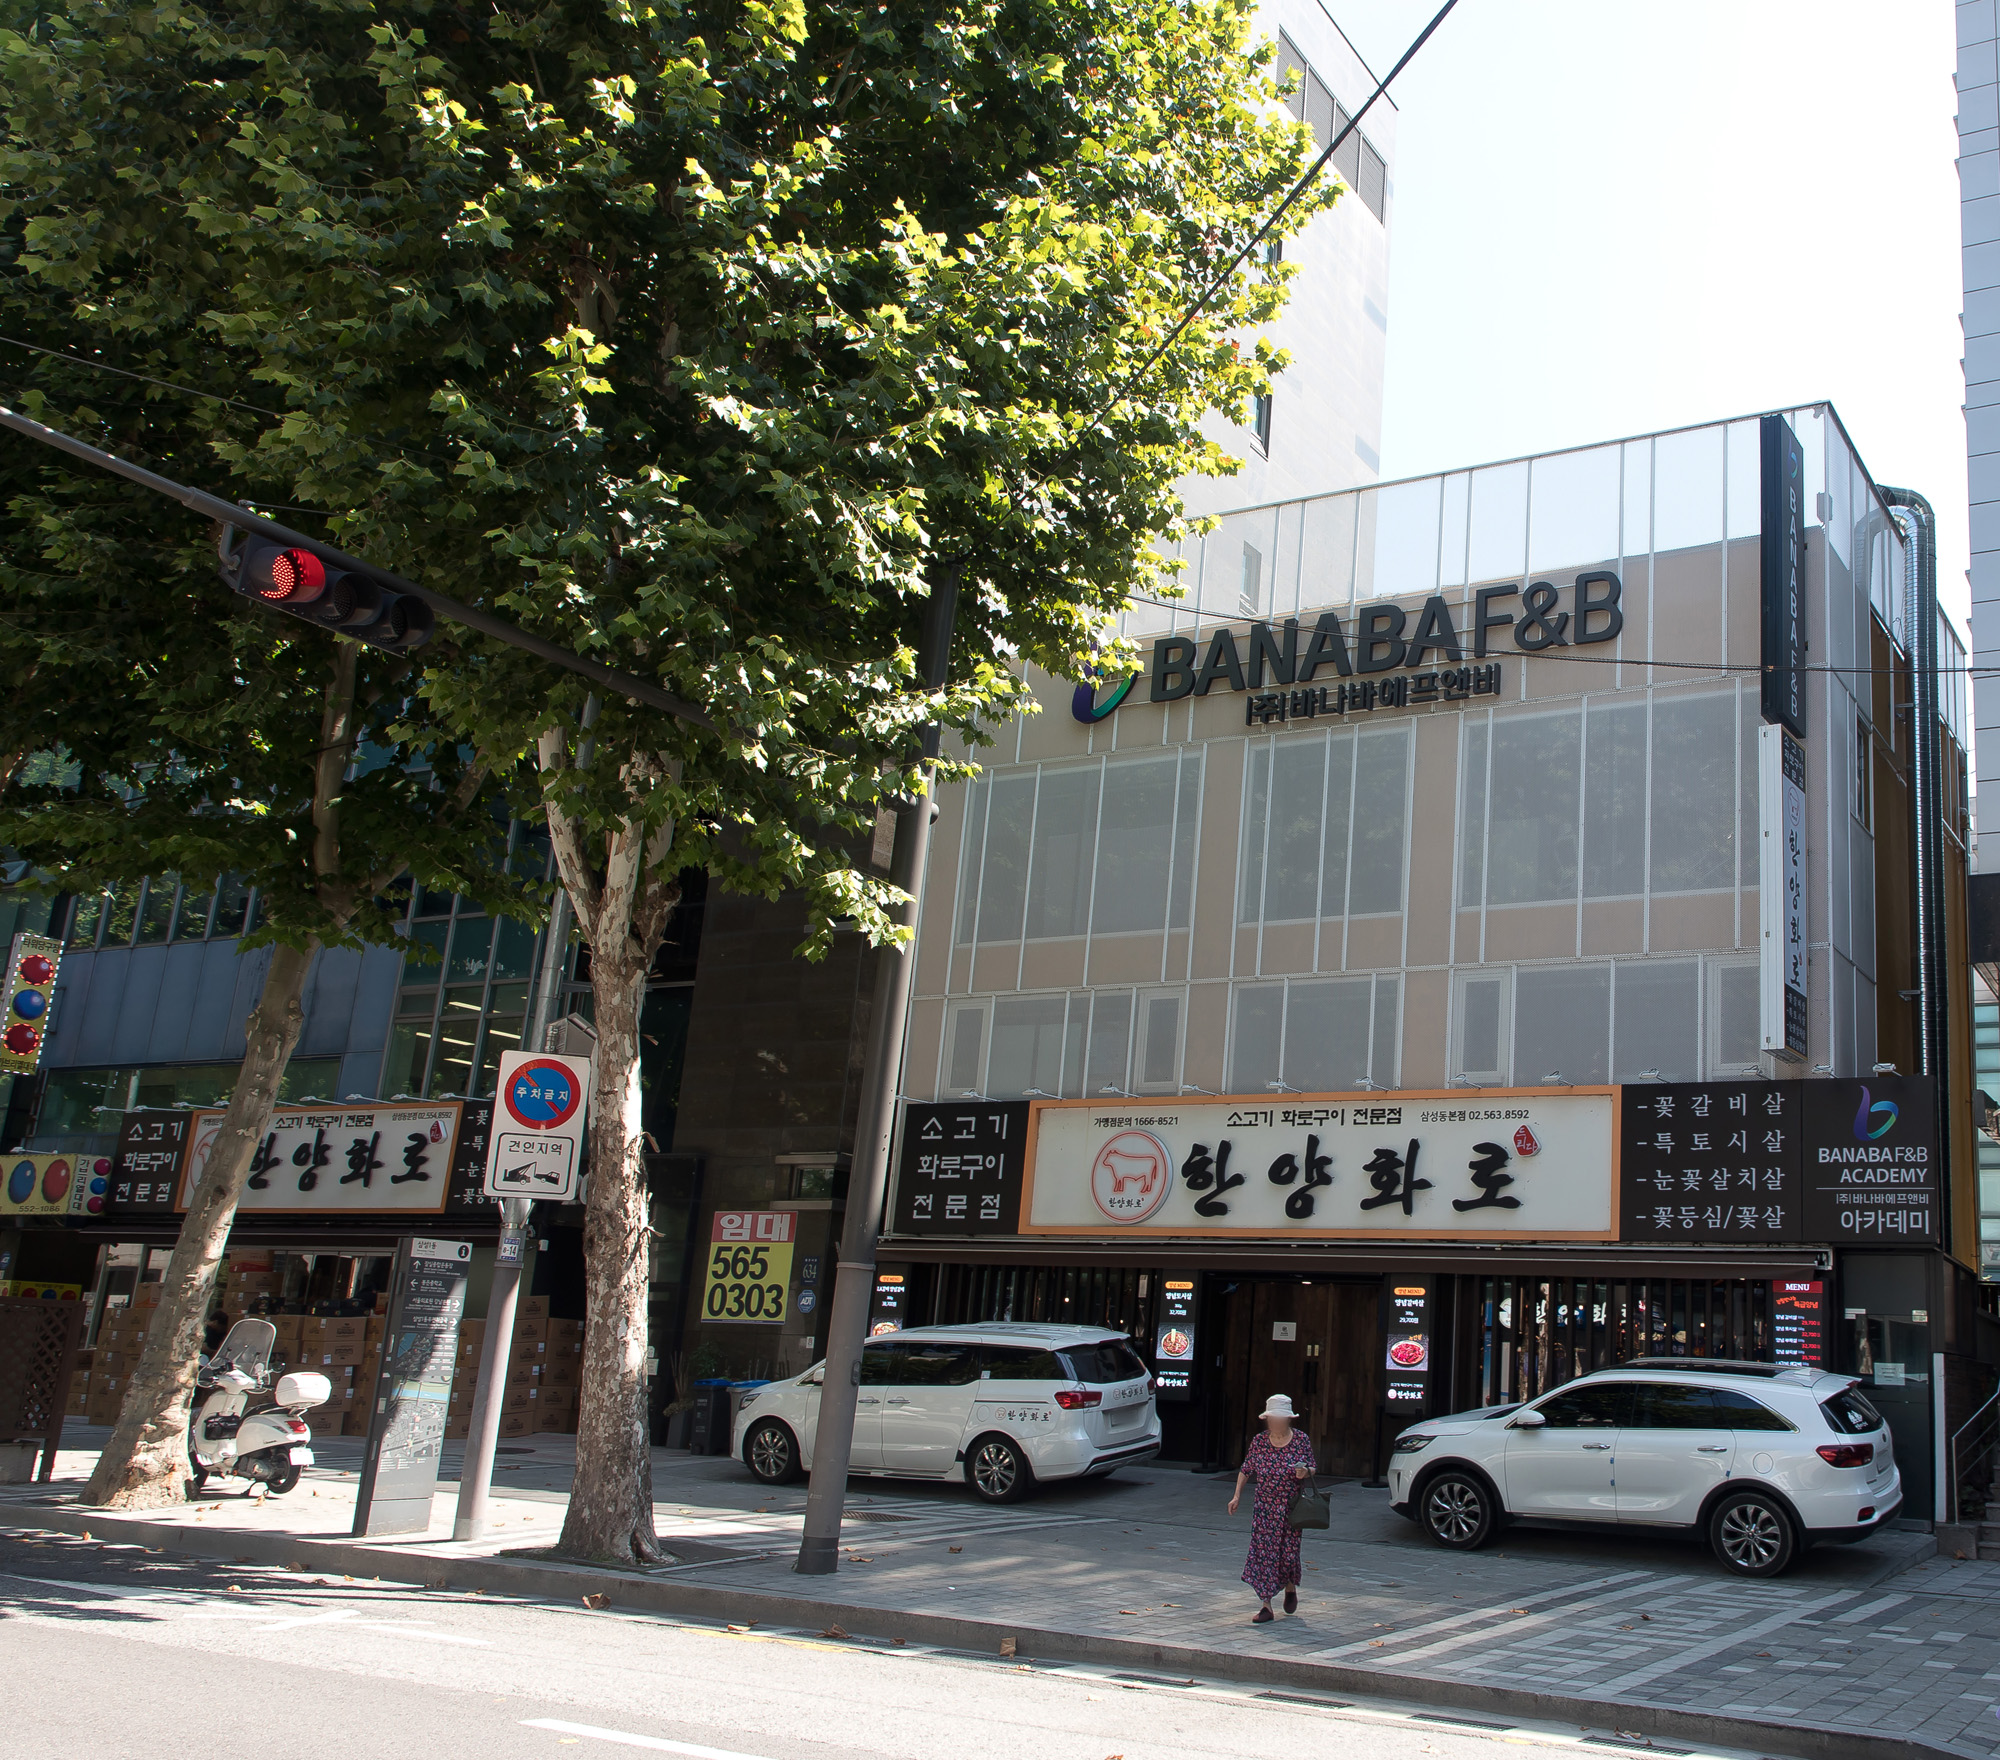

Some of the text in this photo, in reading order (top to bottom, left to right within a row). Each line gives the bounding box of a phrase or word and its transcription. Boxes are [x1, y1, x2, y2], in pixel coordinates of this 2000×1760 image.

[516, 1086, 568, 1101] 주차금지
[275, 1113, 375, 1129] 소고기 화로구이 전문점
[920, 1113, 1009, 1141] 소고기
[1094, 1116, 1179, 1128] 가맹점문의 1666-8521
[1226, 1106, 1402, 1128] 소고기 화로구이 전문점
[1420, 1109, 1530, 1123] 삼성동본점 02.563.8592
[127, 1120, 184, 1142] 소고기
[508, 1140, 563, 1156] 견인지역
[122, 1150, 177, 1172] 화로구이
[917, 1153, 1004, 1180] 화로구이
[1181, 1133, 1524, 1219] 한양화로
[1840, 1168, 1928, 1184] ACADEMY
[115, 1181, 172, 1203] 전문점
[1109, 1197, 1142, 1208] 한양화로
[912, 1193, 1001, 1220] 전문점
[719, 1213, 791, 1241] 임대
[1840, 1209, 1930, 1234] 아카데미
[711, 1245, 770, 1280] 565
[1785, 1283, 1810, 1291] MENU
[707, 1282, 784, 1319] 0303
[800, 1296, 813, 1305] ADT
[1007, 1410, 1050, 1422] 한양화로
